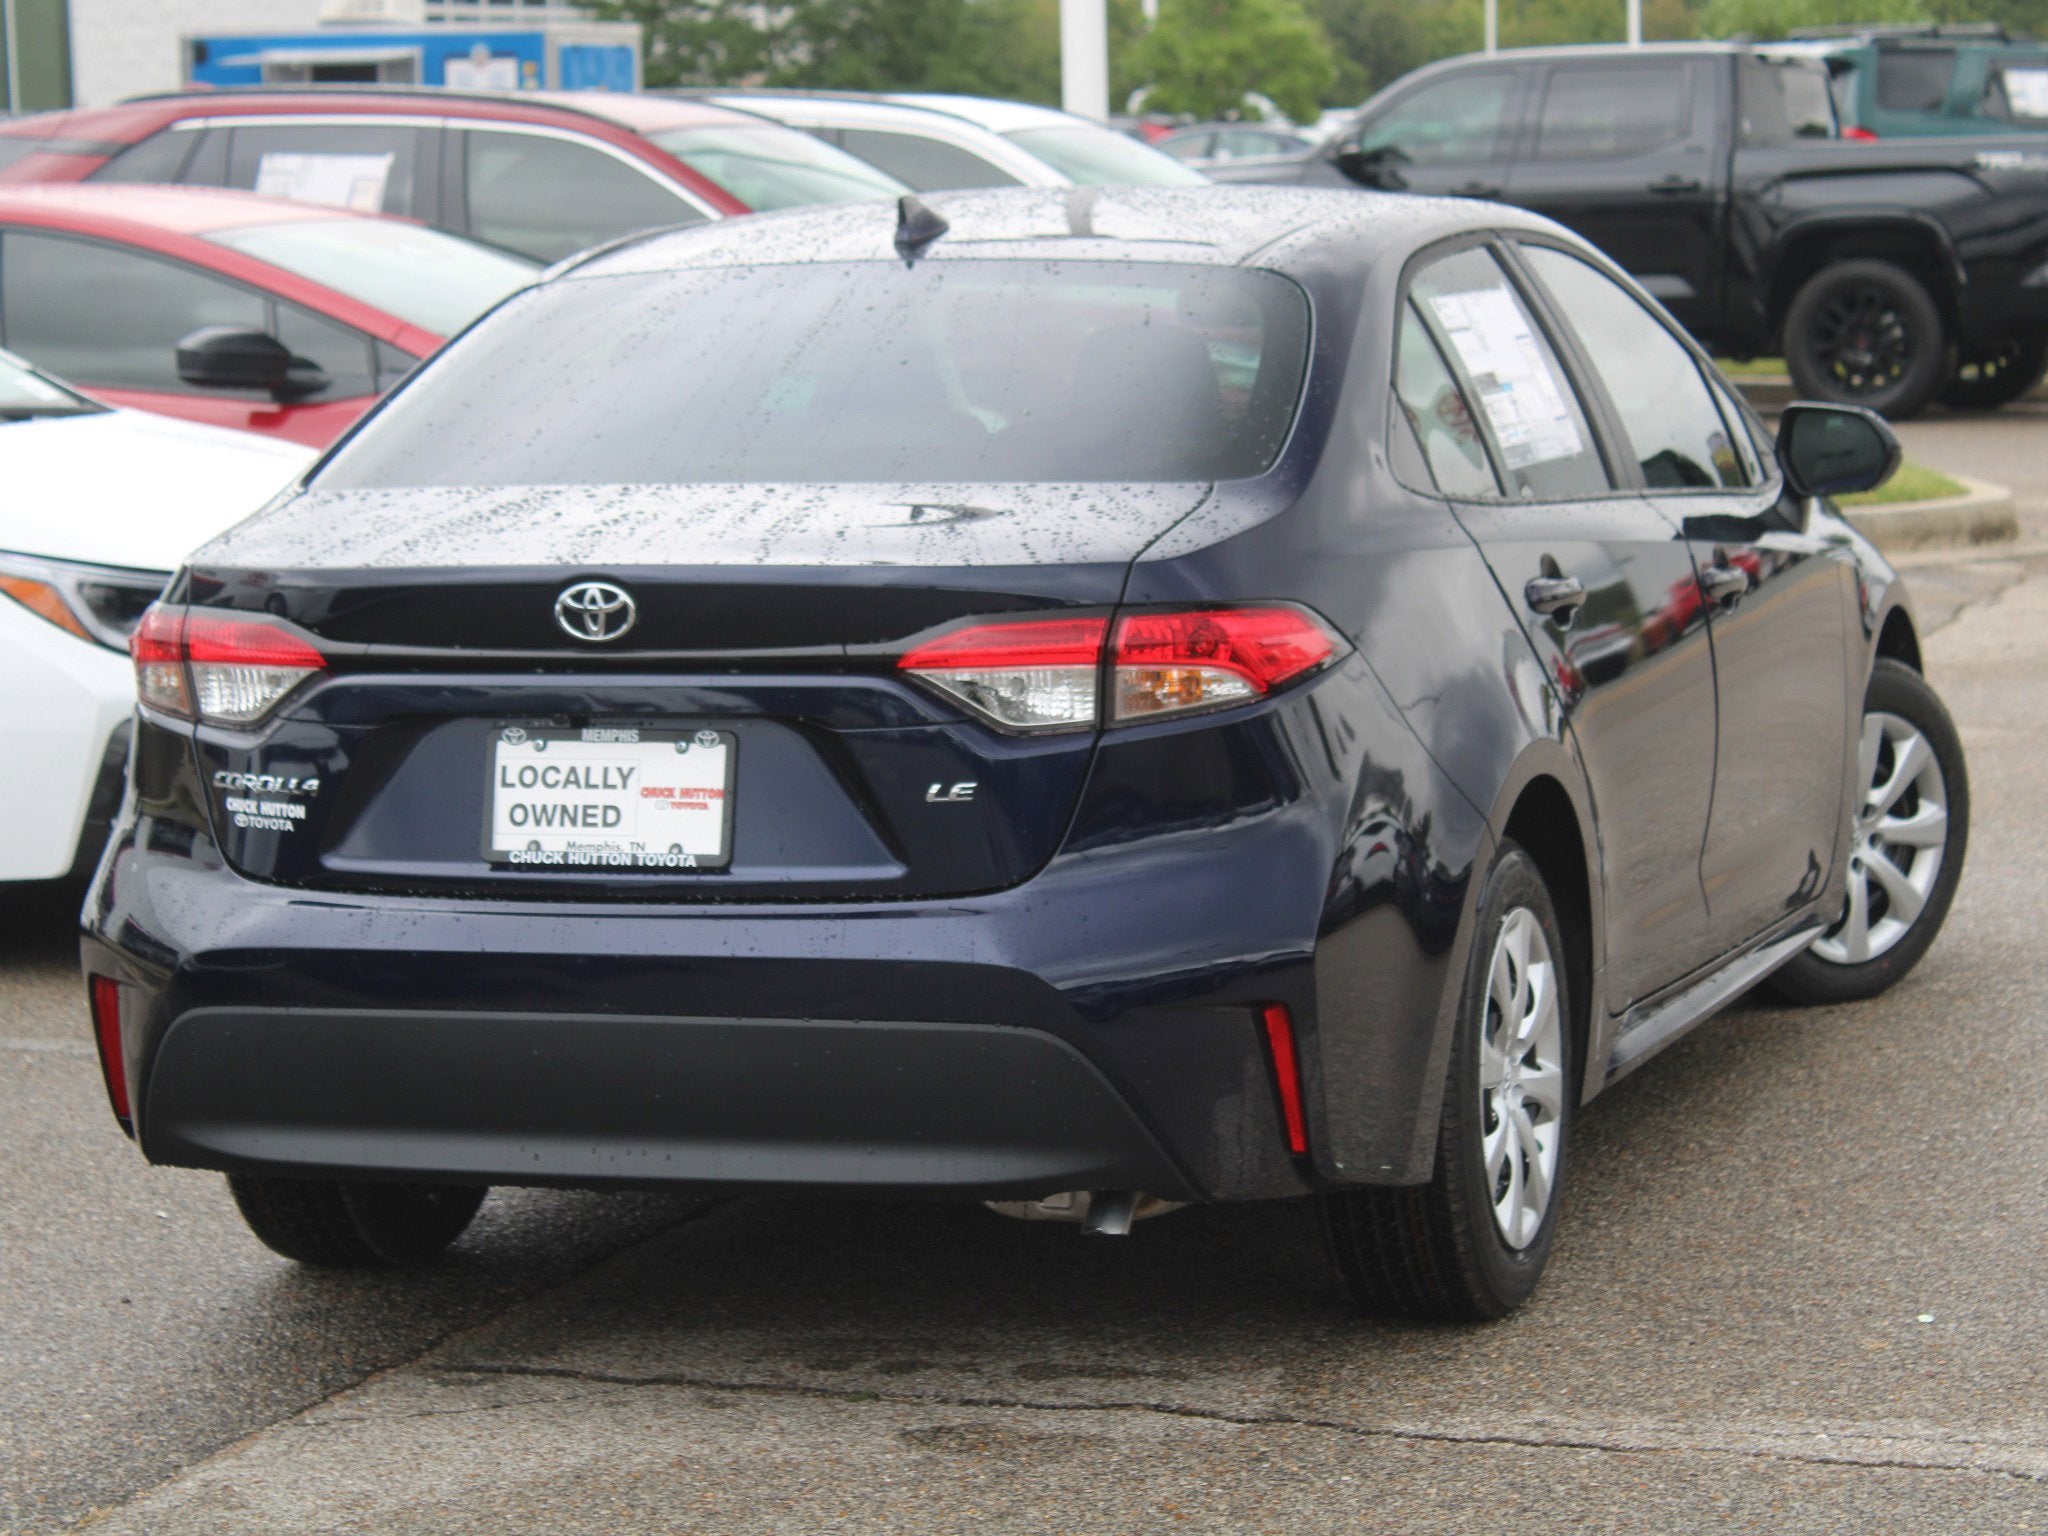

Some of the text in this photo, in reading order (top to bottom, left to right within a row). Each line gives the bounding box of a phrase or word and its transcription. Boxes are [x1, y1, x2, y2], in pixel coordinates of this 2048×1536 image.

[581, 728, 639, 743] MEMPHIS
[212, 770, 320, 797] COROLLA
[500, 765, 636, 790] LOCALLY
[641, 787, 724, 800] CHUCK HUTTON
[926, 782, 978, 802] LE
[226, 796, 305, 820] CHUCK HUTTON
[670, 801, 709, 810] TOYOTA
[248, 815, 294, 832] TOYOTA
[509, 803, 622, 828] OWNED
[629, 842, 646, 852] TN
[509, 851, 697, 867] CHUCK HUTTON TOYOTA
